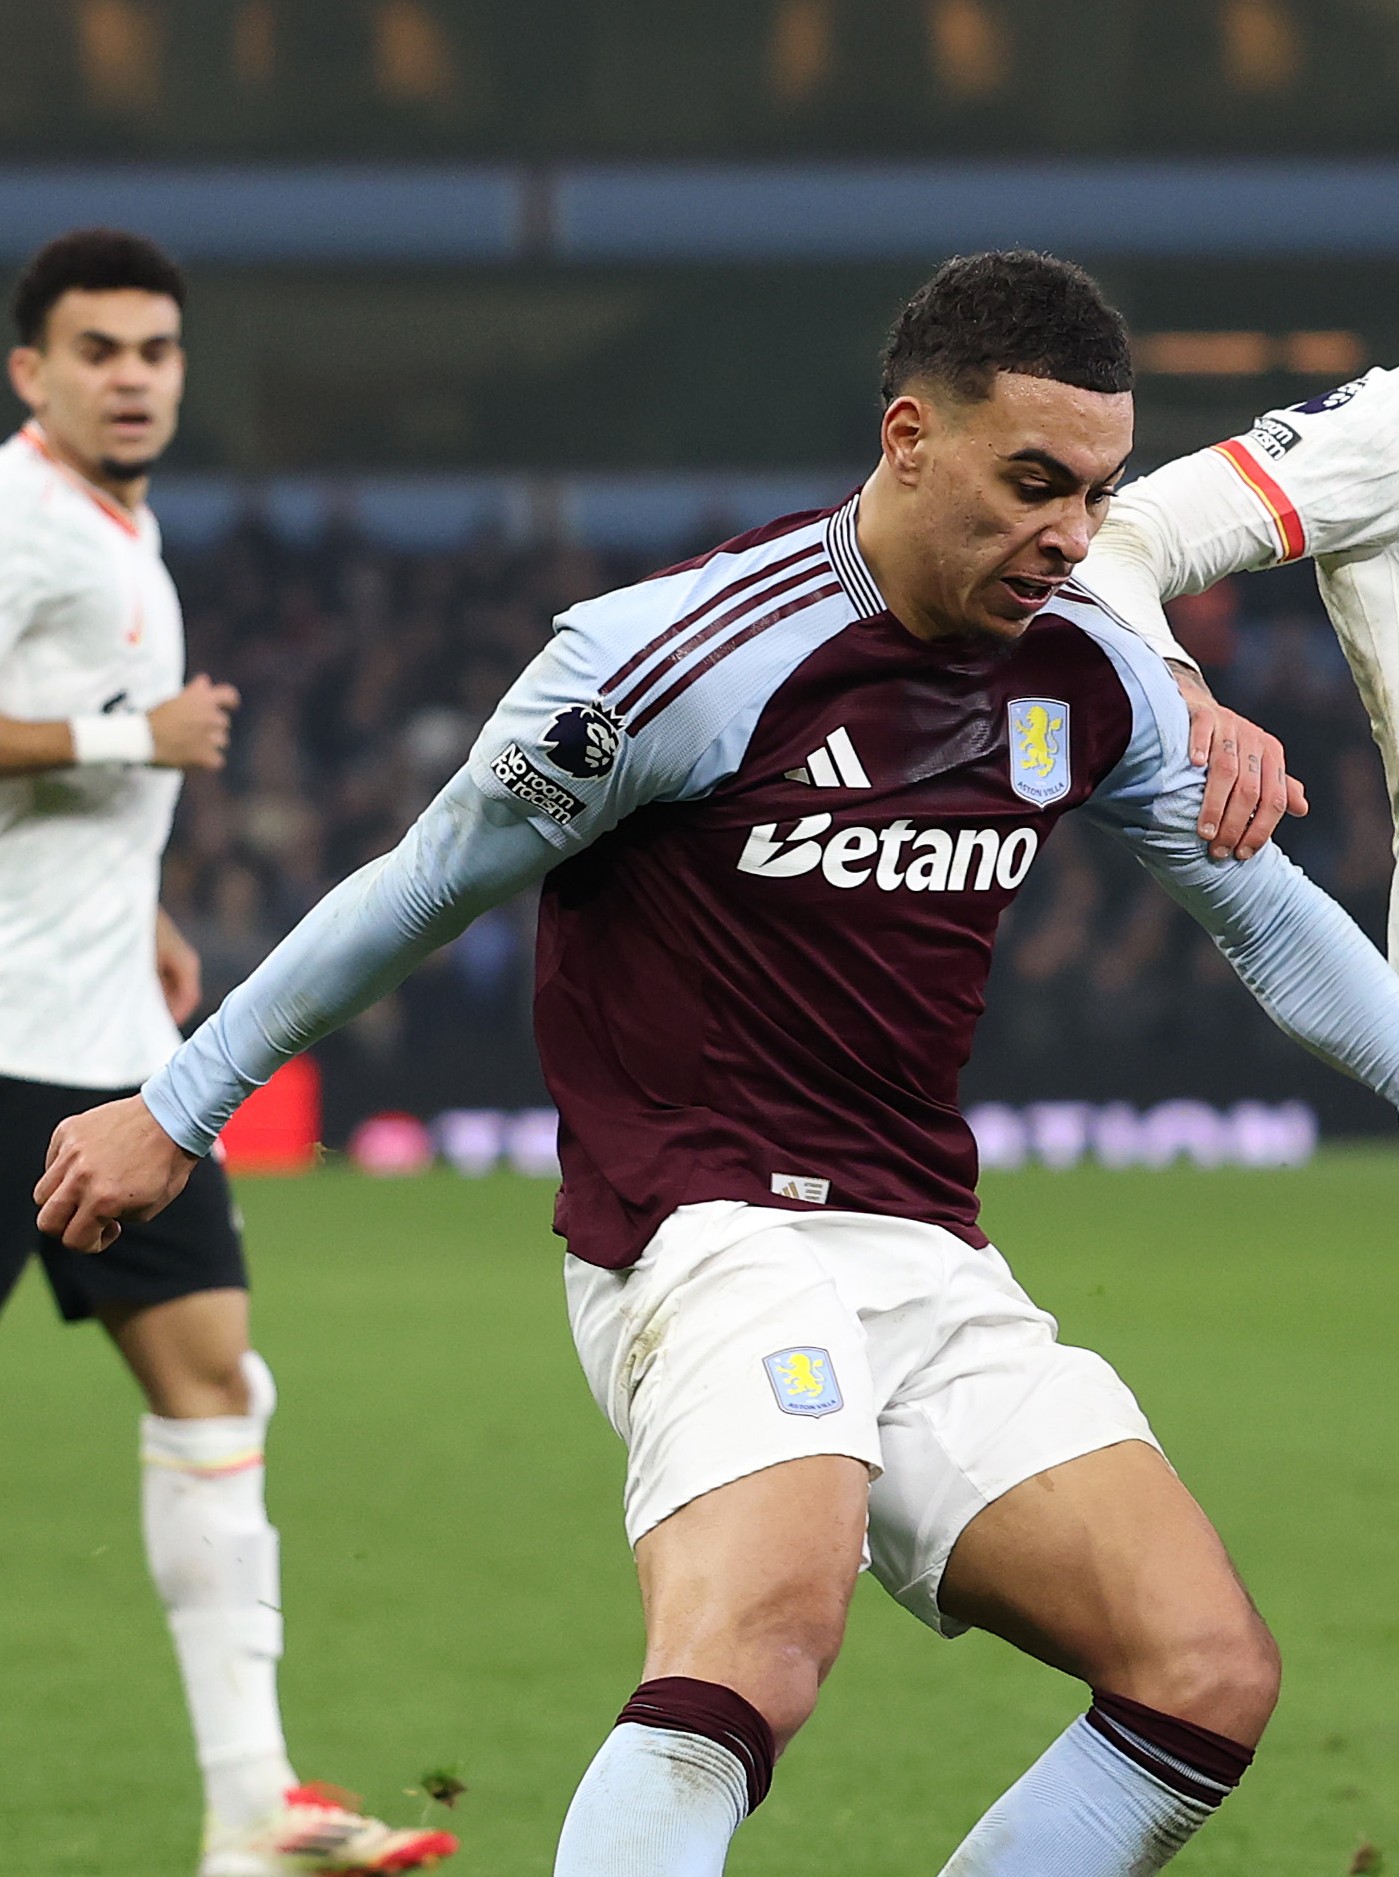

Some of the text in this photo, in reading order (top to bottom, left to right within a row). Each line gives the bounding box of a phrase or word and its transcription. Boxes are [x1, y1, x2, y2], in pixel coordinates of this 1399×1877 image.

[500, 743, 575, 809] No room
[511, 781, 572, 825] racism
[1016, 781, 1042, 797] ASTON
[736, 812, 1039, 892] Betano
